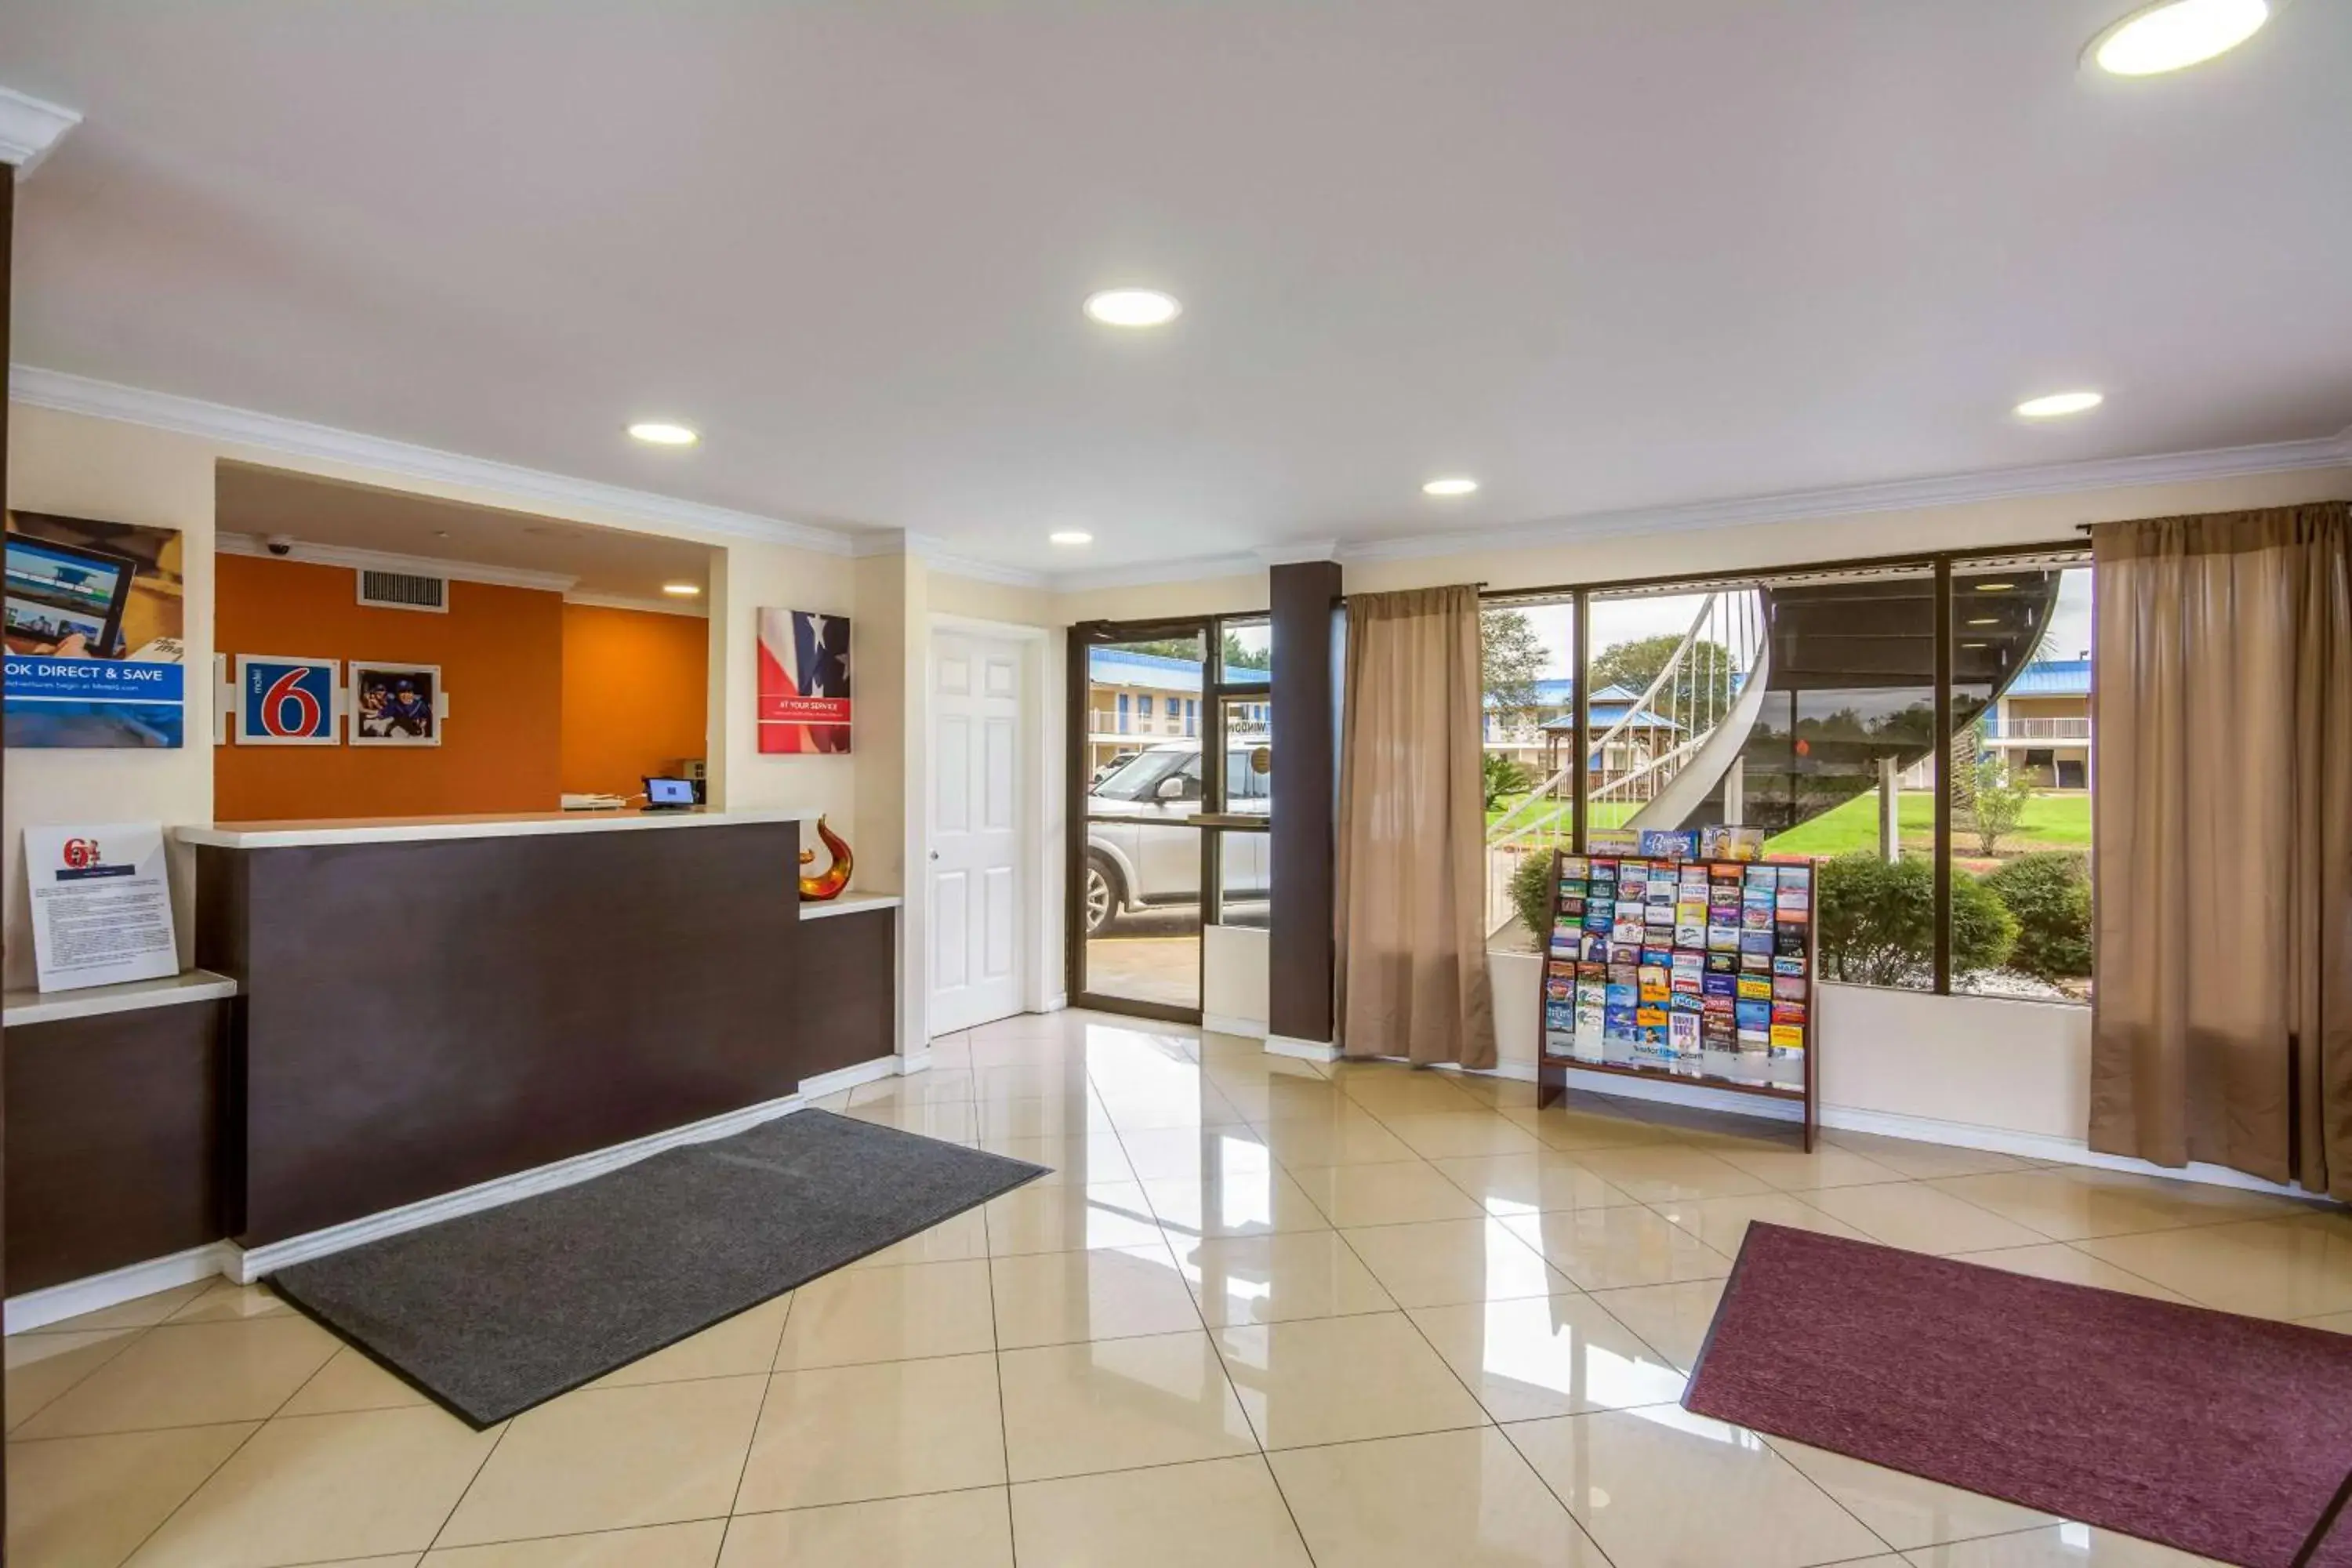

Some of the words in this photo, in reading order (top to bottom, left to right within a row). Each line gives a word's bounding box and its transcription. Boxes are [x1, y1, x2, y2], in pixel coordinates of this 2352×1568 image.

[38, 665, 101, 678] DIRECT
[105, 667, 118, 680] &
[122, 669, 163, 681] SAVE
[261, 667, 321, 737] 6
